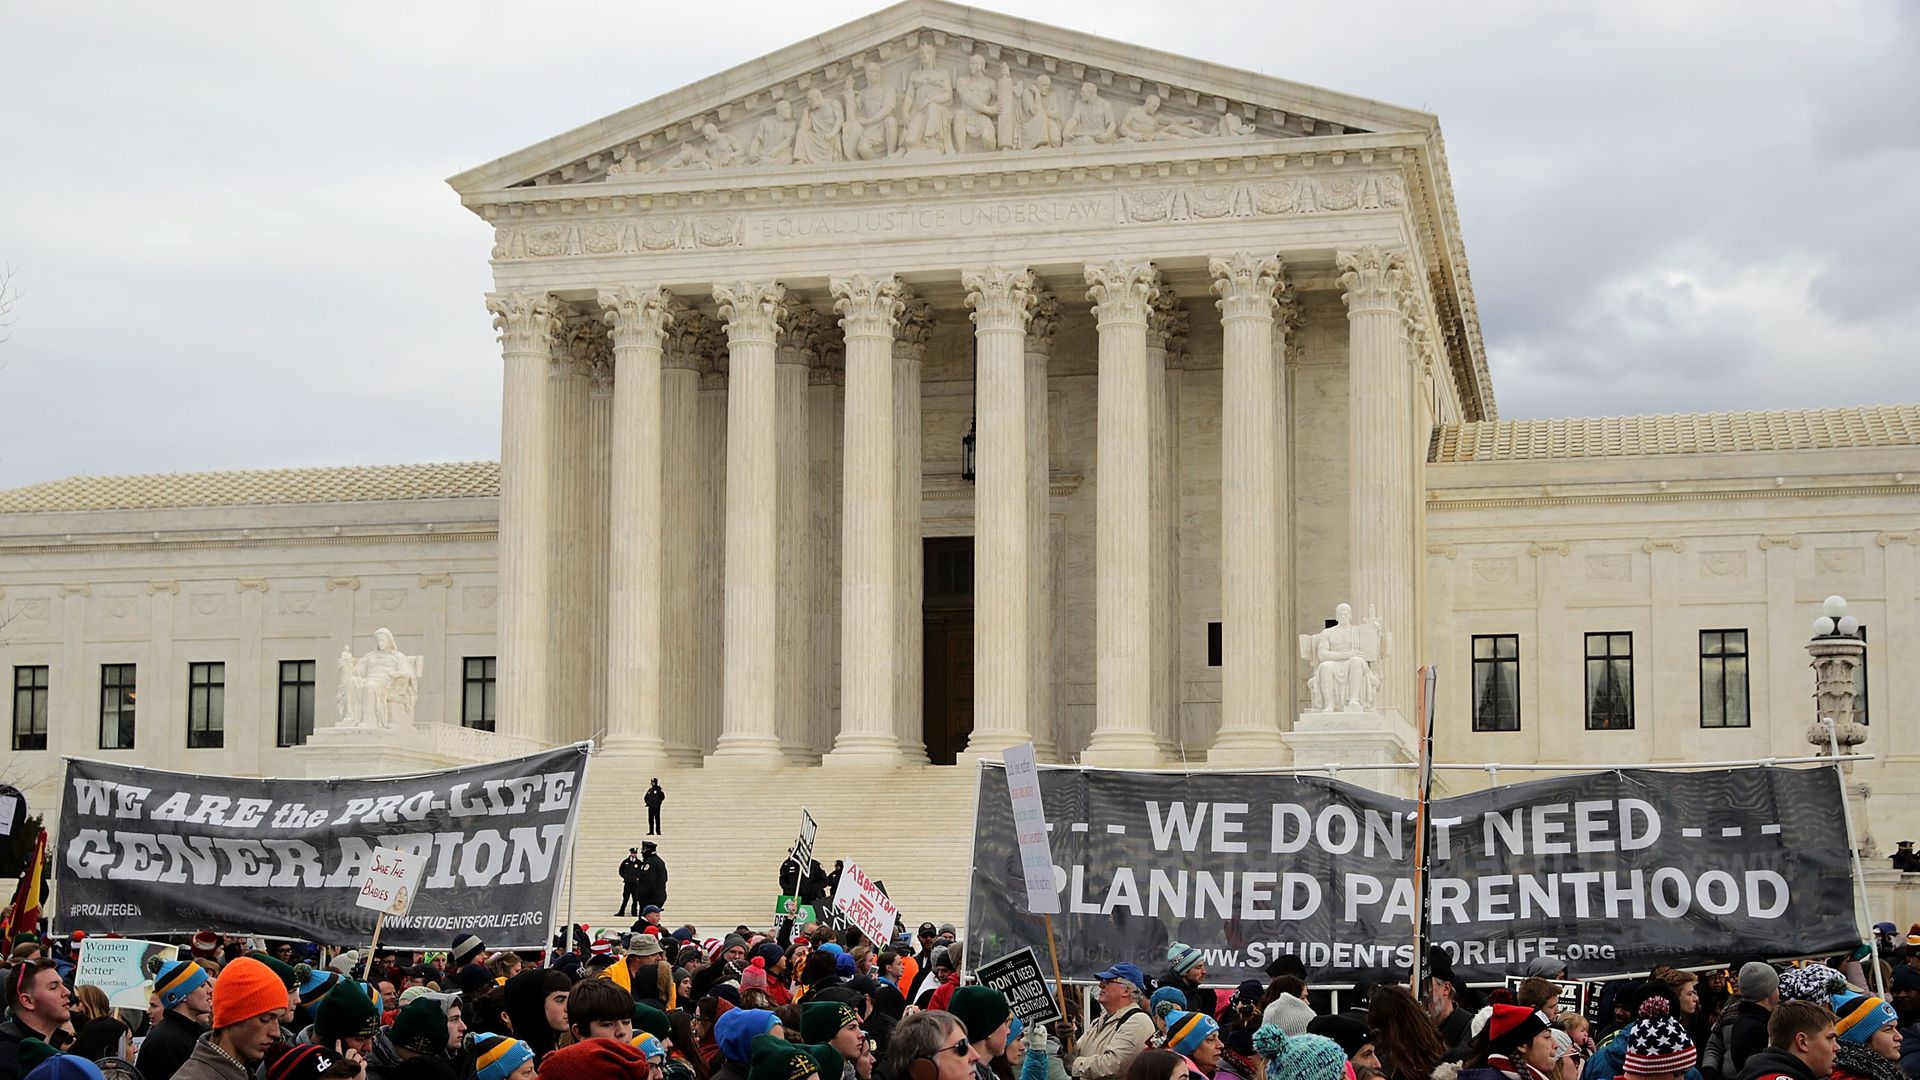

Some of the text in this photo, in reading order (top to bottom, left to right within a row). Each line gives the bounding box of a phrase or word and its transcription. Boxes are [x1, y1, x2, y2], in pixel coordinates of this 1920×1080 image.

[762, 199, 1103, 238] EQUAL JUSTICE UNDER LAW
[73, 772, 575, 828] WE ARE the PRO-LIFE
[1145, 798, 1661, 860] WE DON'T NEED
[847, 863, 897, 916] ABORTION
[1345, 866, 1790, 925] PARENTHOOD
[70, 903, 142, 917] #PROLIFEGEN
[83, 953, 126, 963] deserve
[85, 942, 129, 952] Women
[81, 966, 114, 975] better
[988, 965, 1036, 991] DON'T NEED
[1003, 979, 1043, 1007] LANNED
[1013, 996, 1049, 1017] RENTHOOD
